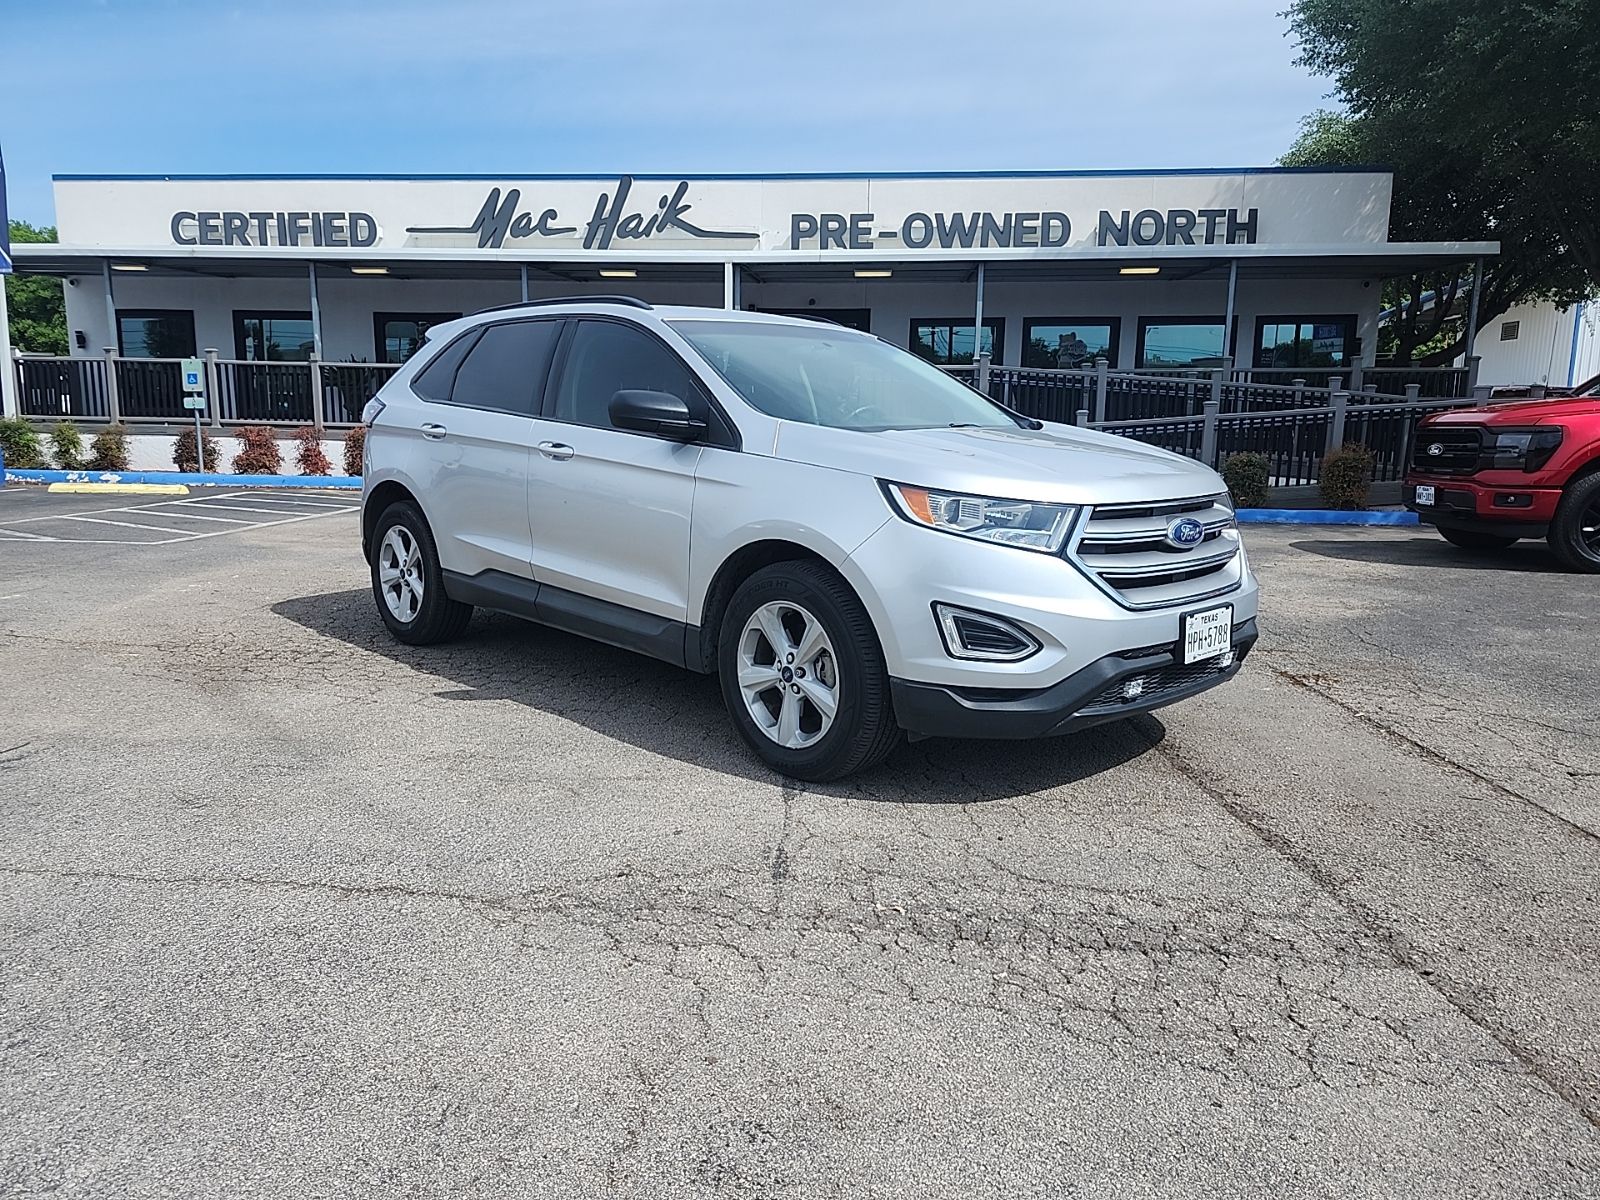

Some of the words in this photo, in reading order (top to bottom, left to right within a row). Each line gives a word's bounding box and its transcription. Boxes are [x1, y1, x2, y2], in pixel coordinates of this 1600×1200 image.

[171, 211, 377, 247] CERTIFIED
[406, 187, 577, 249] Mac
[583, 175, 760, 250] Haik
[790, 211, 1071, 250] PRE-OWNED
[1098, 208, 1258, 246] NORTH
[1180, 524, 1200, 541] Ford
[1201, 613, 1219, 624] TEXAS
